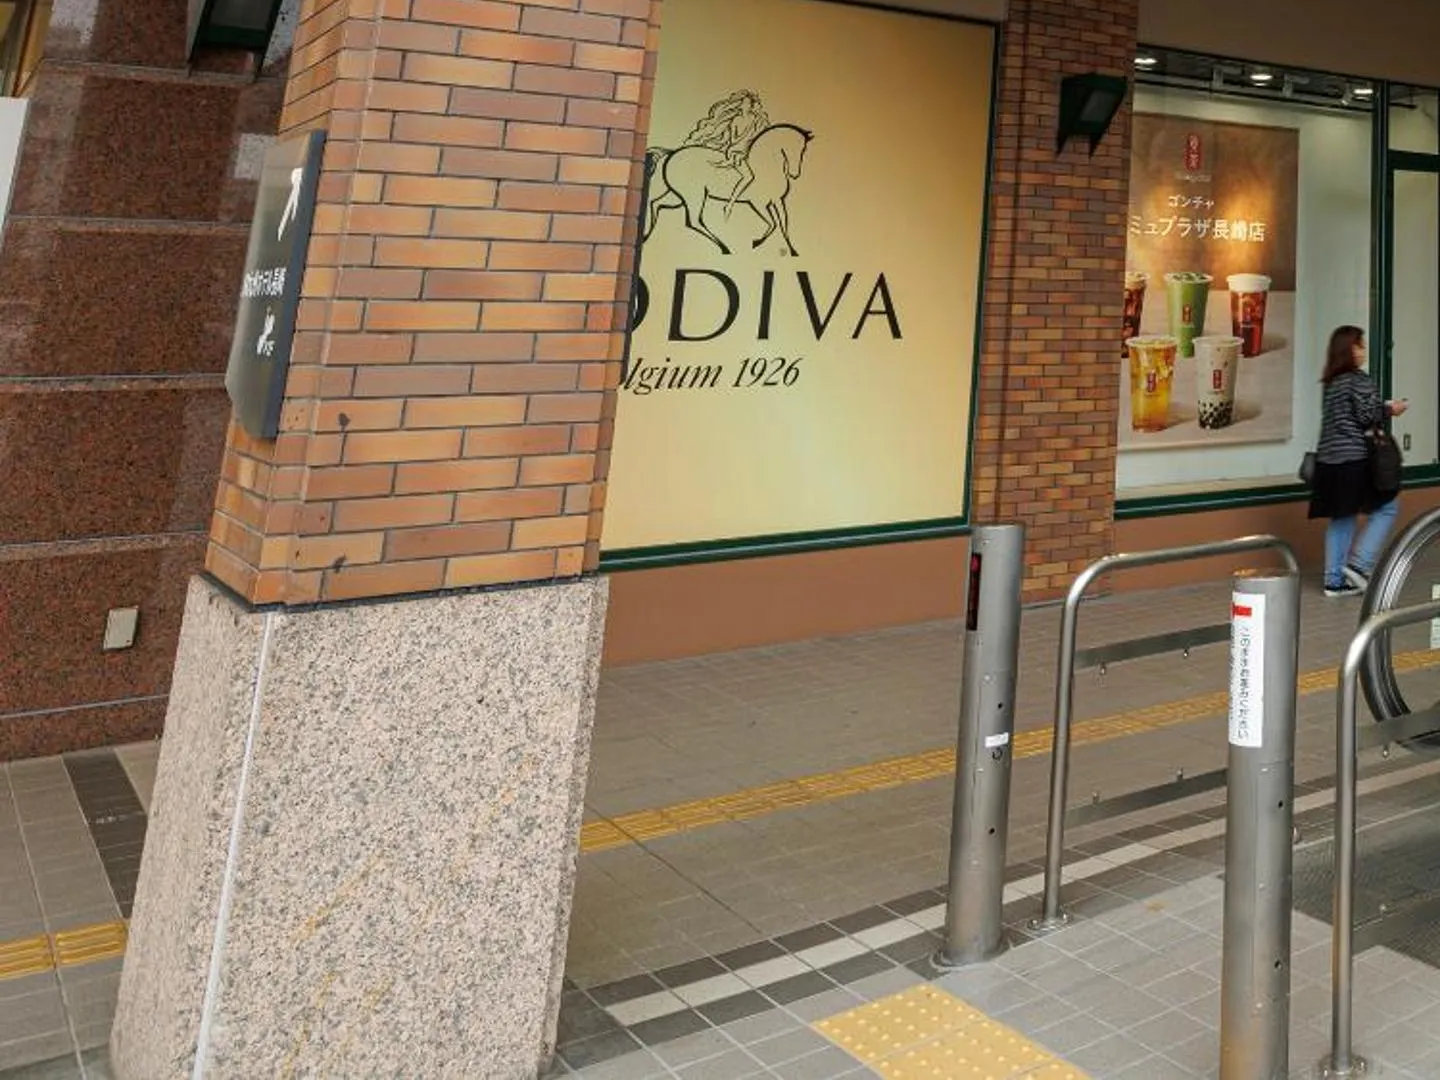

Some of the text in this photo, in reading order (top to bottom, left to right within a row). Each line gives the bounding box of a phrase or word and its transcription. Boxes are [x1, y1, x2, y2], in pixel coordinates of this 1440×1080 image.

[1168, 194, 1215, 210] ゴンチャ
[1129, 215, 1267, 242] ミュプラザ長崎店
[630, 268, 903, 342] DIVA
[620, 356, 802, 396] lgium 1926
